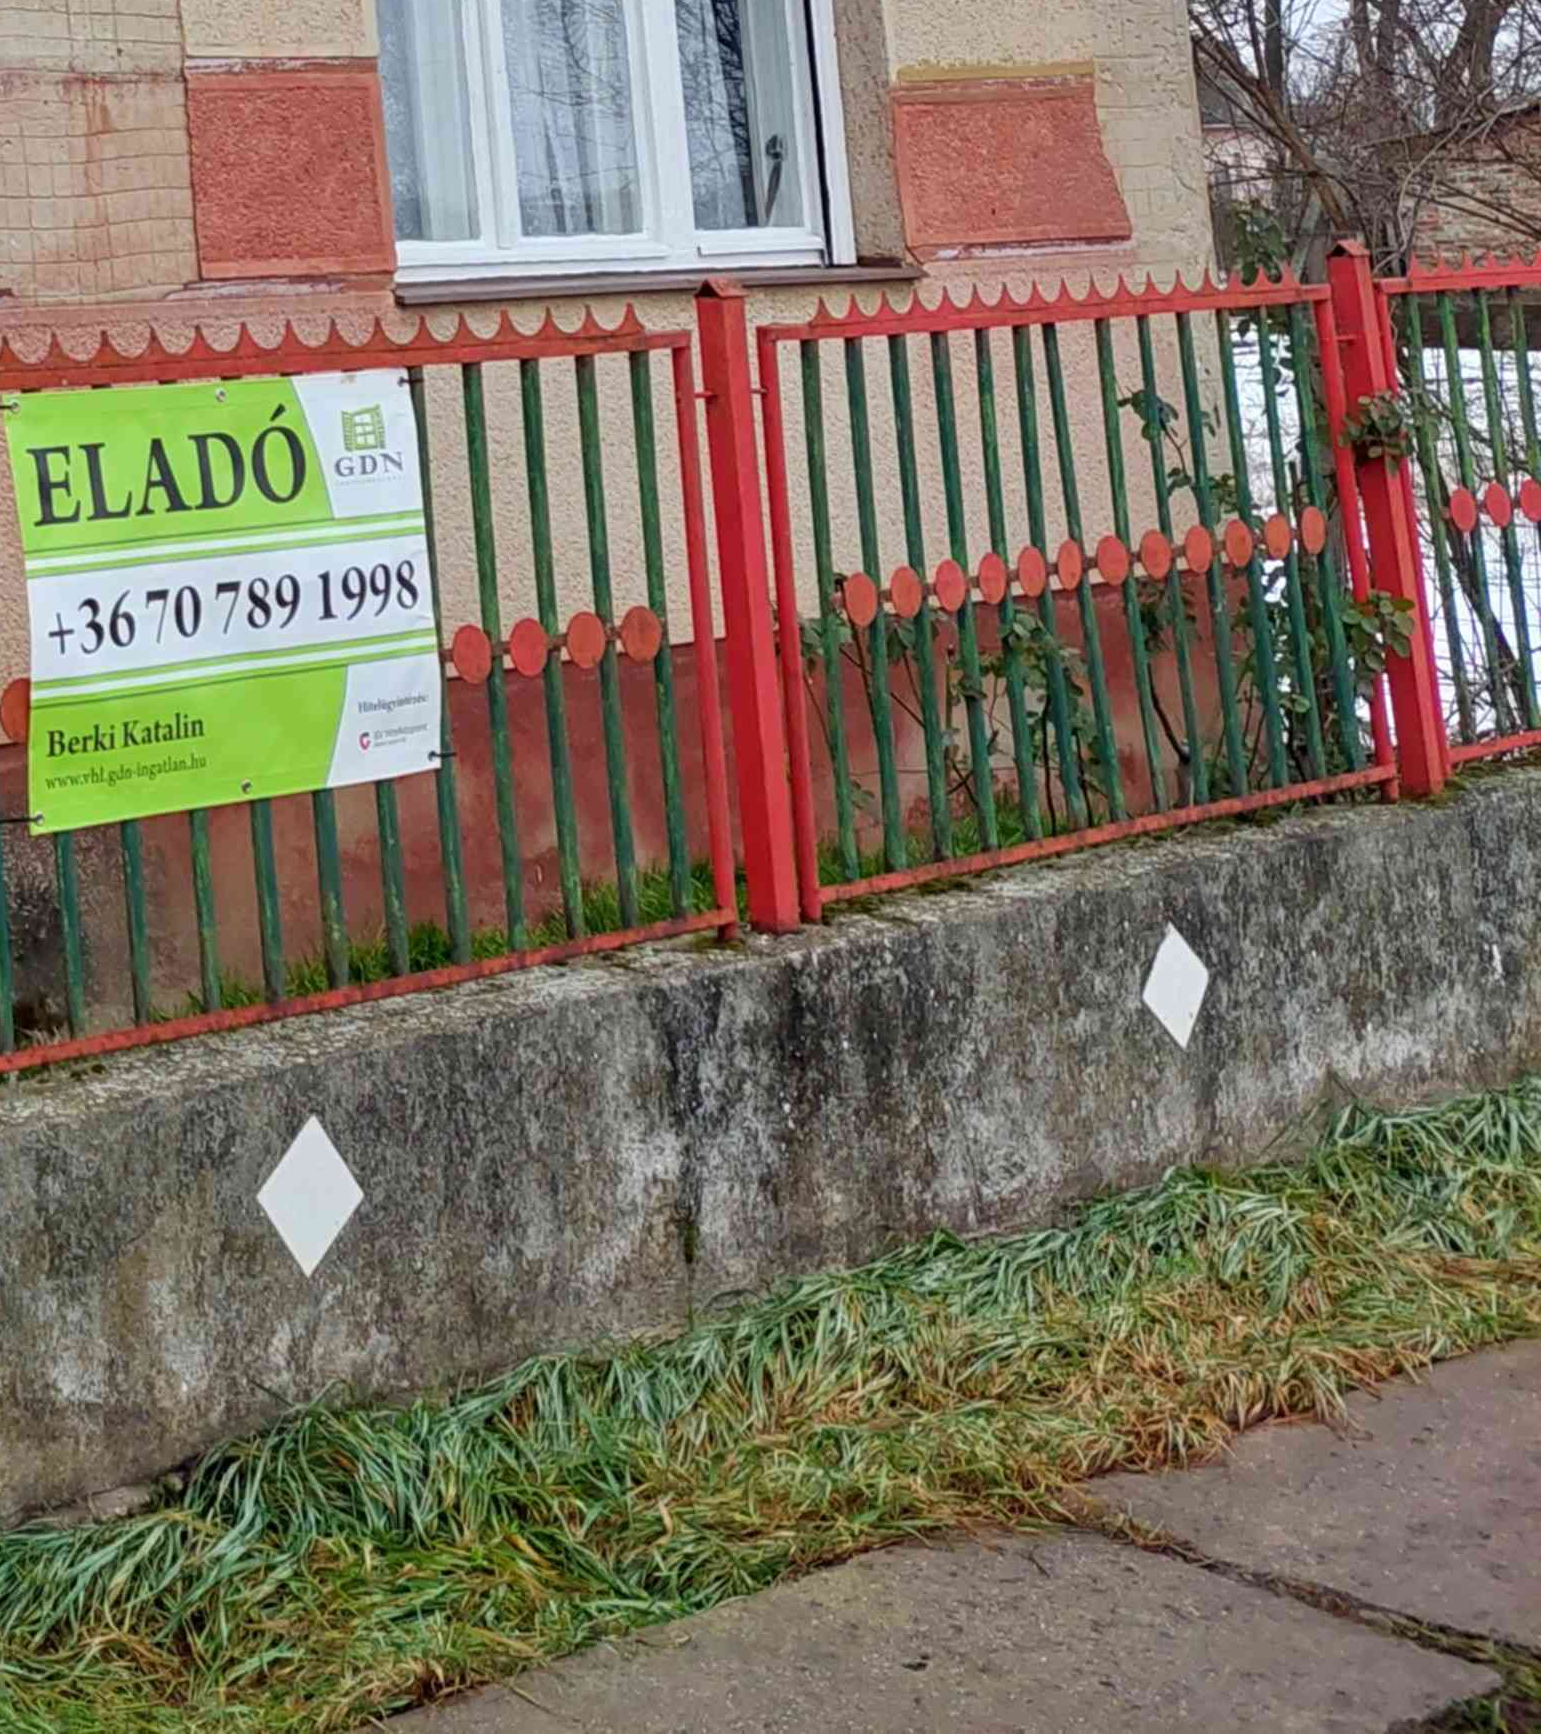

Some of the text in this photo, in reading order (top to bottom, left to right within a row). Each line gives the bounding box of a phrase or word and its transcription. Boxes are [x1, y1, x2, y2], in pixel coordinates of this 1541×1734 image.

[27, 403, 308, 528] ELADÓ
[334, 451, 404, 477] GDN
[48, 560, 419, 655] +36 70 789 1998
[47, 713, 205, 757] Berki Katalin
